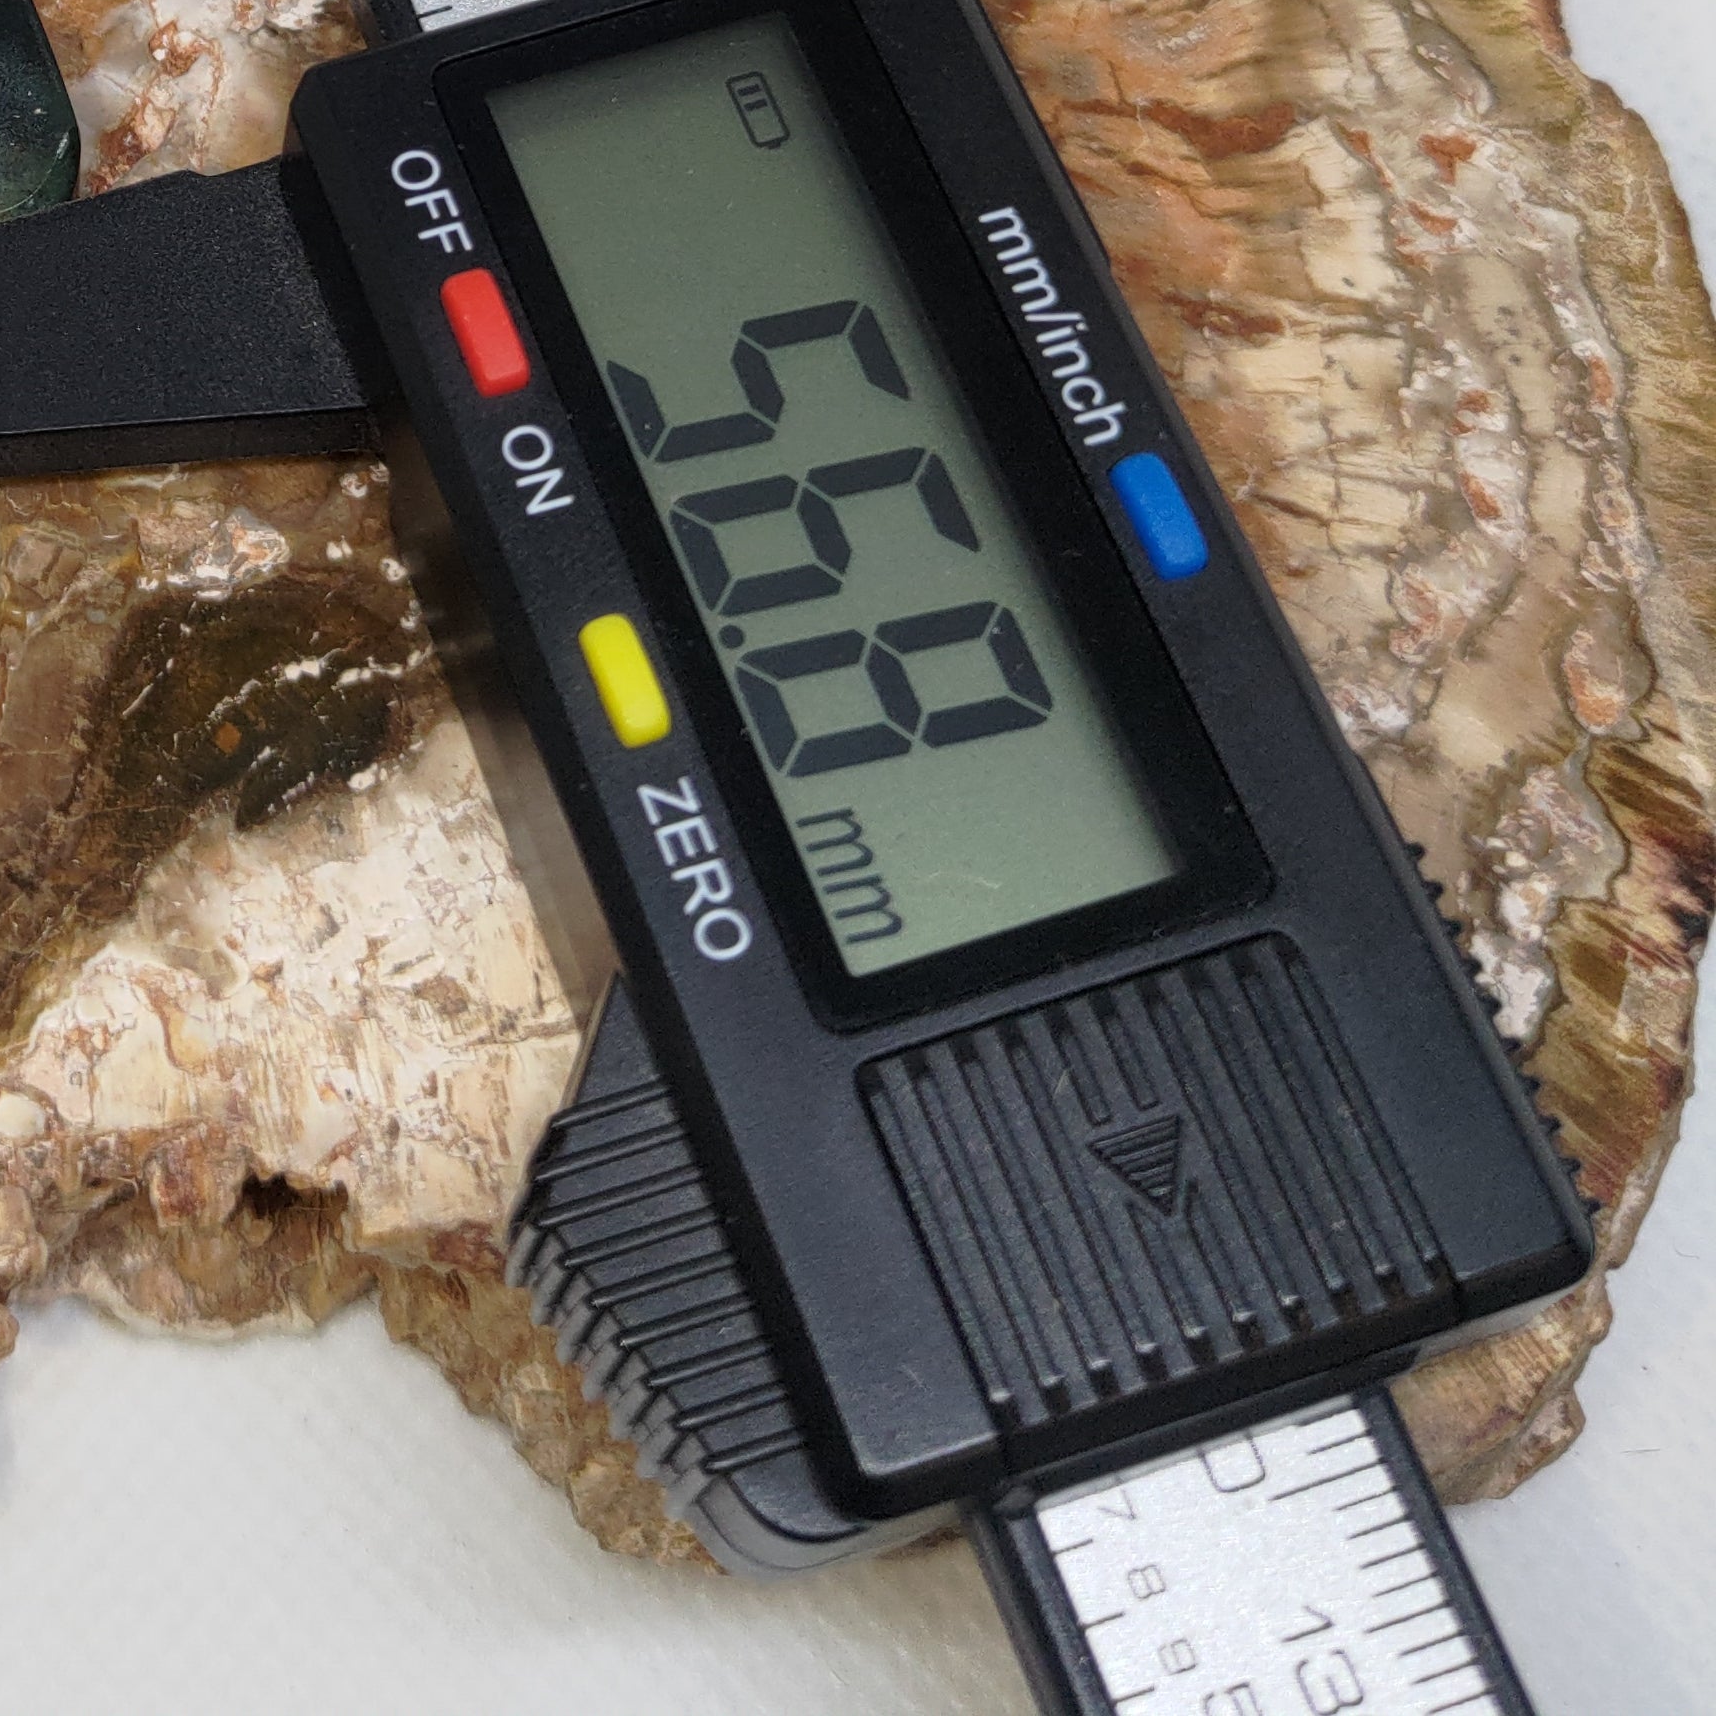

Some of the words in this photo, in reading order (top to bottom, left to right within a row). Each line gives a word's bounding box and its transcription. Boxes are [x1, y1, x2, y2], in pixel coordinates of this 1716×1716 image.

[389, 148, 473, 254] OFF
[978, 206, 1126, 447] mm/inch
[500, 423, 574, 516] ON
[606, 298, 1053, 778] 56.8
[637, 776, 754, 961] ZERO
[796, 806, 904, 948] mm
[1126, 1563, 1167, 1602] 8
[1158, 1637, 1198, 1676] 9
